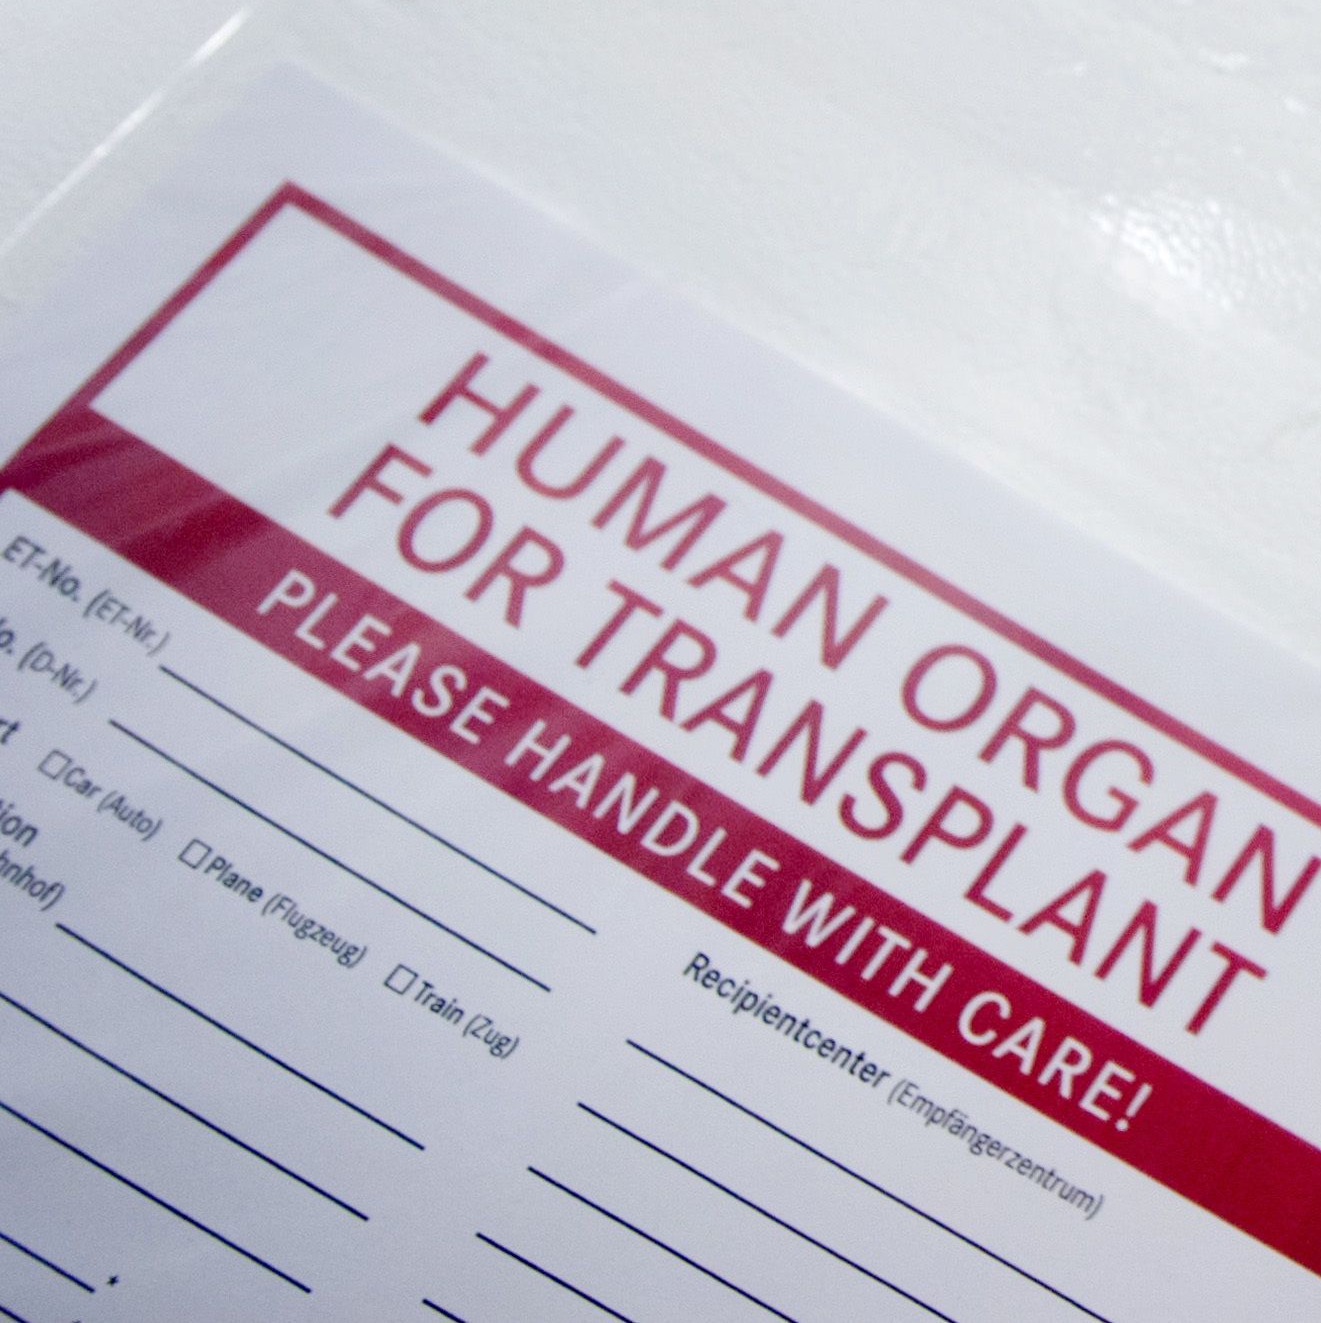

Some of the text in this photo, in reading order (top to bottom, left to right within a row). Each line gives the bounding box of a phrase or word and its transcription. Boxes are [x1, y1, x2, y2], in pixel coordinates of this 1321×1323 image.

[1, 534, 80, 603] ET-No.
[82, 588, 172, 658] (ET-Nr.)
[416, 352, 888, 671] HUMAN
[17, 640, 98, 705] (D-Nr.)
[327, 443, 1269, 1040] FOR TRANSPLANT
[62, 765, 521, 1061] Car (Auto) Plane (Flugzeug) Train (Zug)
[256, 569, 1153, 1133] PLEASE HANDLE WITH CARE!
[682, 951, 1106, 1222] Recipientcenter (Empfängerzentrum)
